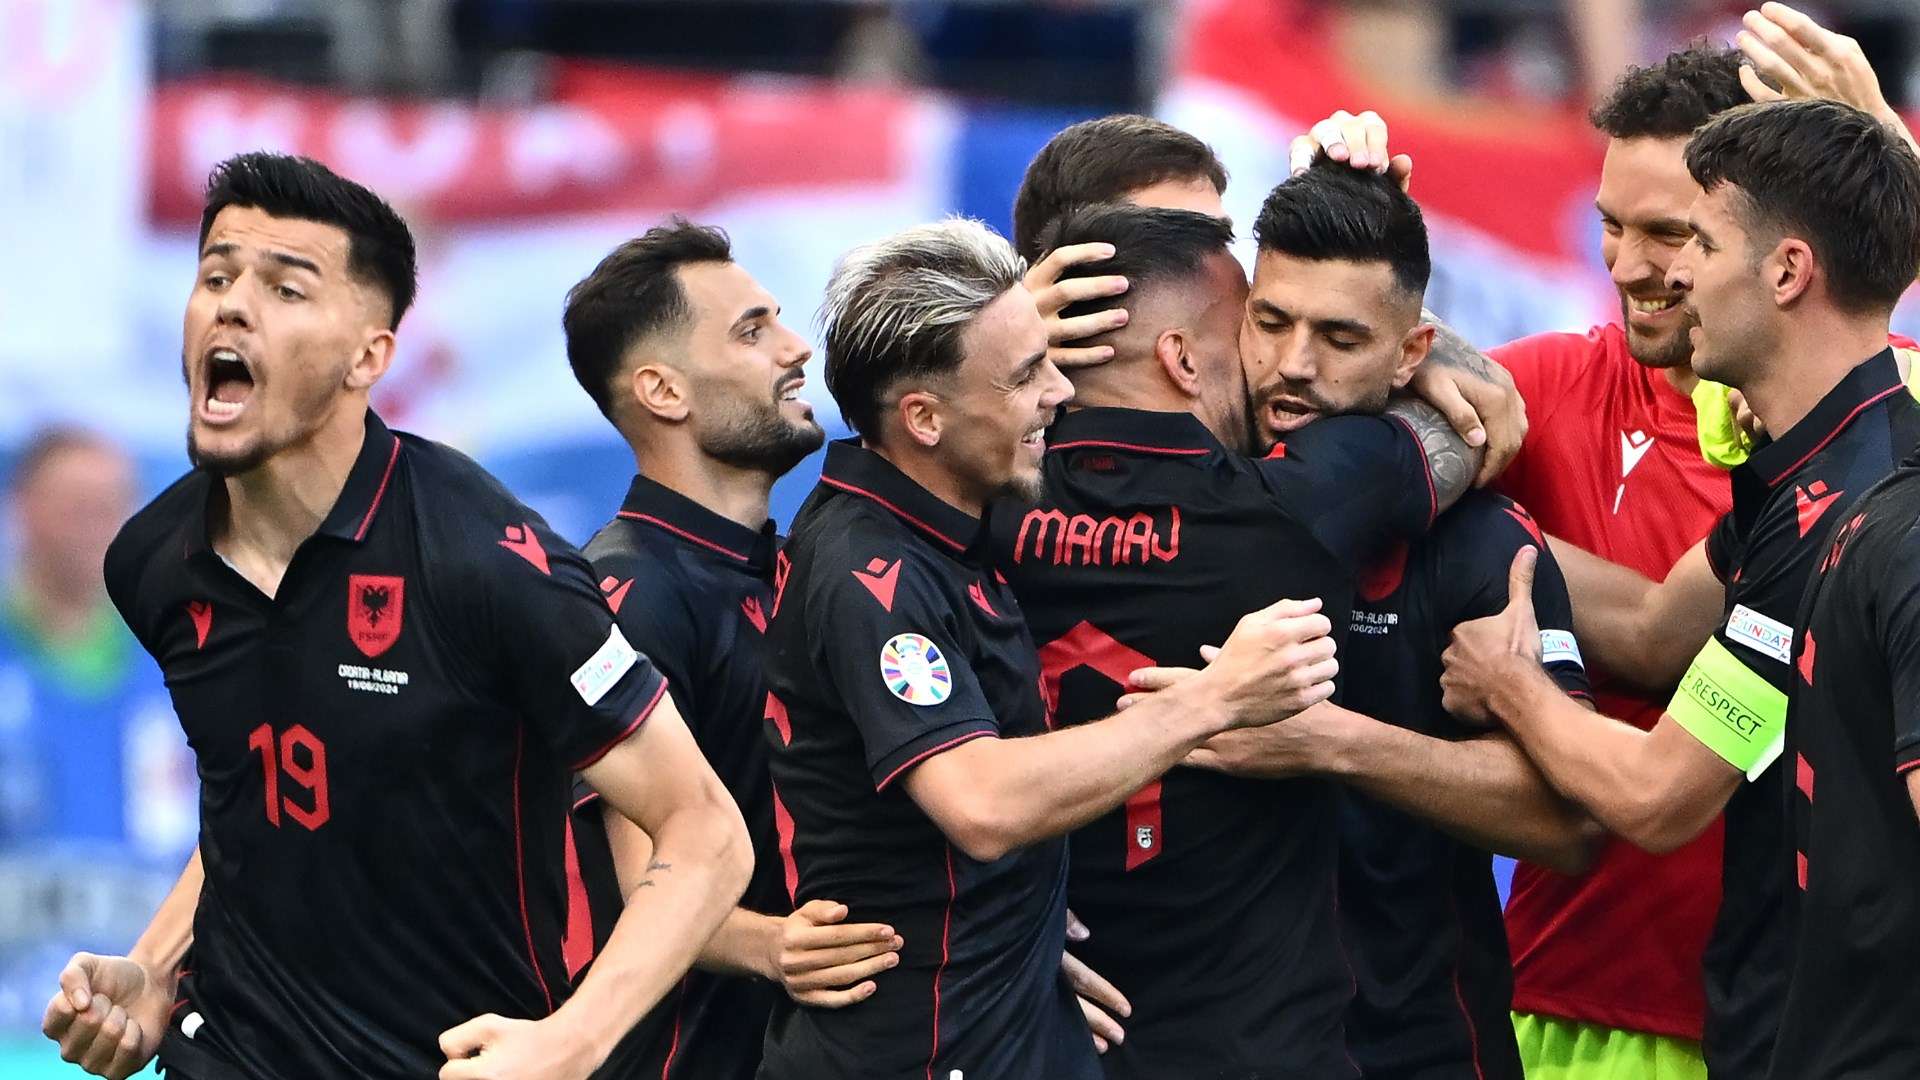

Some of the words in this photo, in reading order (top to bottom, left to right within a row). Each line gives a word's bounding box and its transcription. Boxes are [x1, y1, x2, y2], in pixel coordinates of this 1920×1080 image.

[1613, 484, 1626, 515] 1
[1013, 505, 1181, 567] MANAJ
[1730, 614, 1791, 649] FOUNDAT
[1691, 677, 1763, 736] RESPECT
[249, 722, 330, 832] 19
